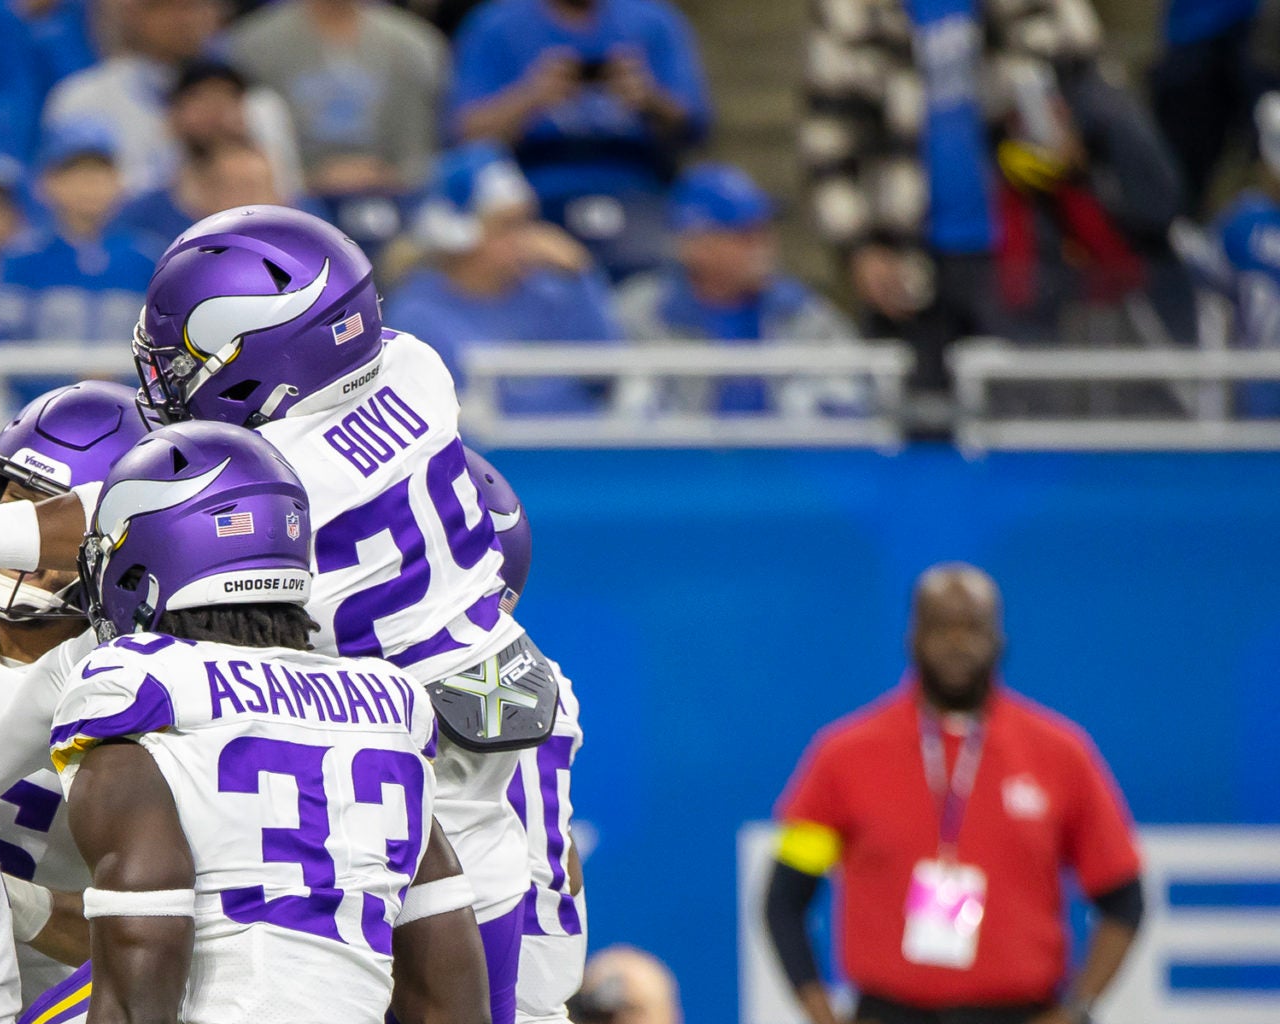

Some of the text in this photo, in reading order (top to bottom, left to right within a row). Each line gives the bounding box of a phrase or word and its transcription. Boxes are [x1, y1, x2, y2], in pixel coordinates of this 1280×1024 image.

[323, 386, 429, 478] BOYD
[224, 577, 304, 593] CHOOSE LOVE
[203, 660, 402, 725] ASAMOAH
[218, 735, 425, 957] 33
